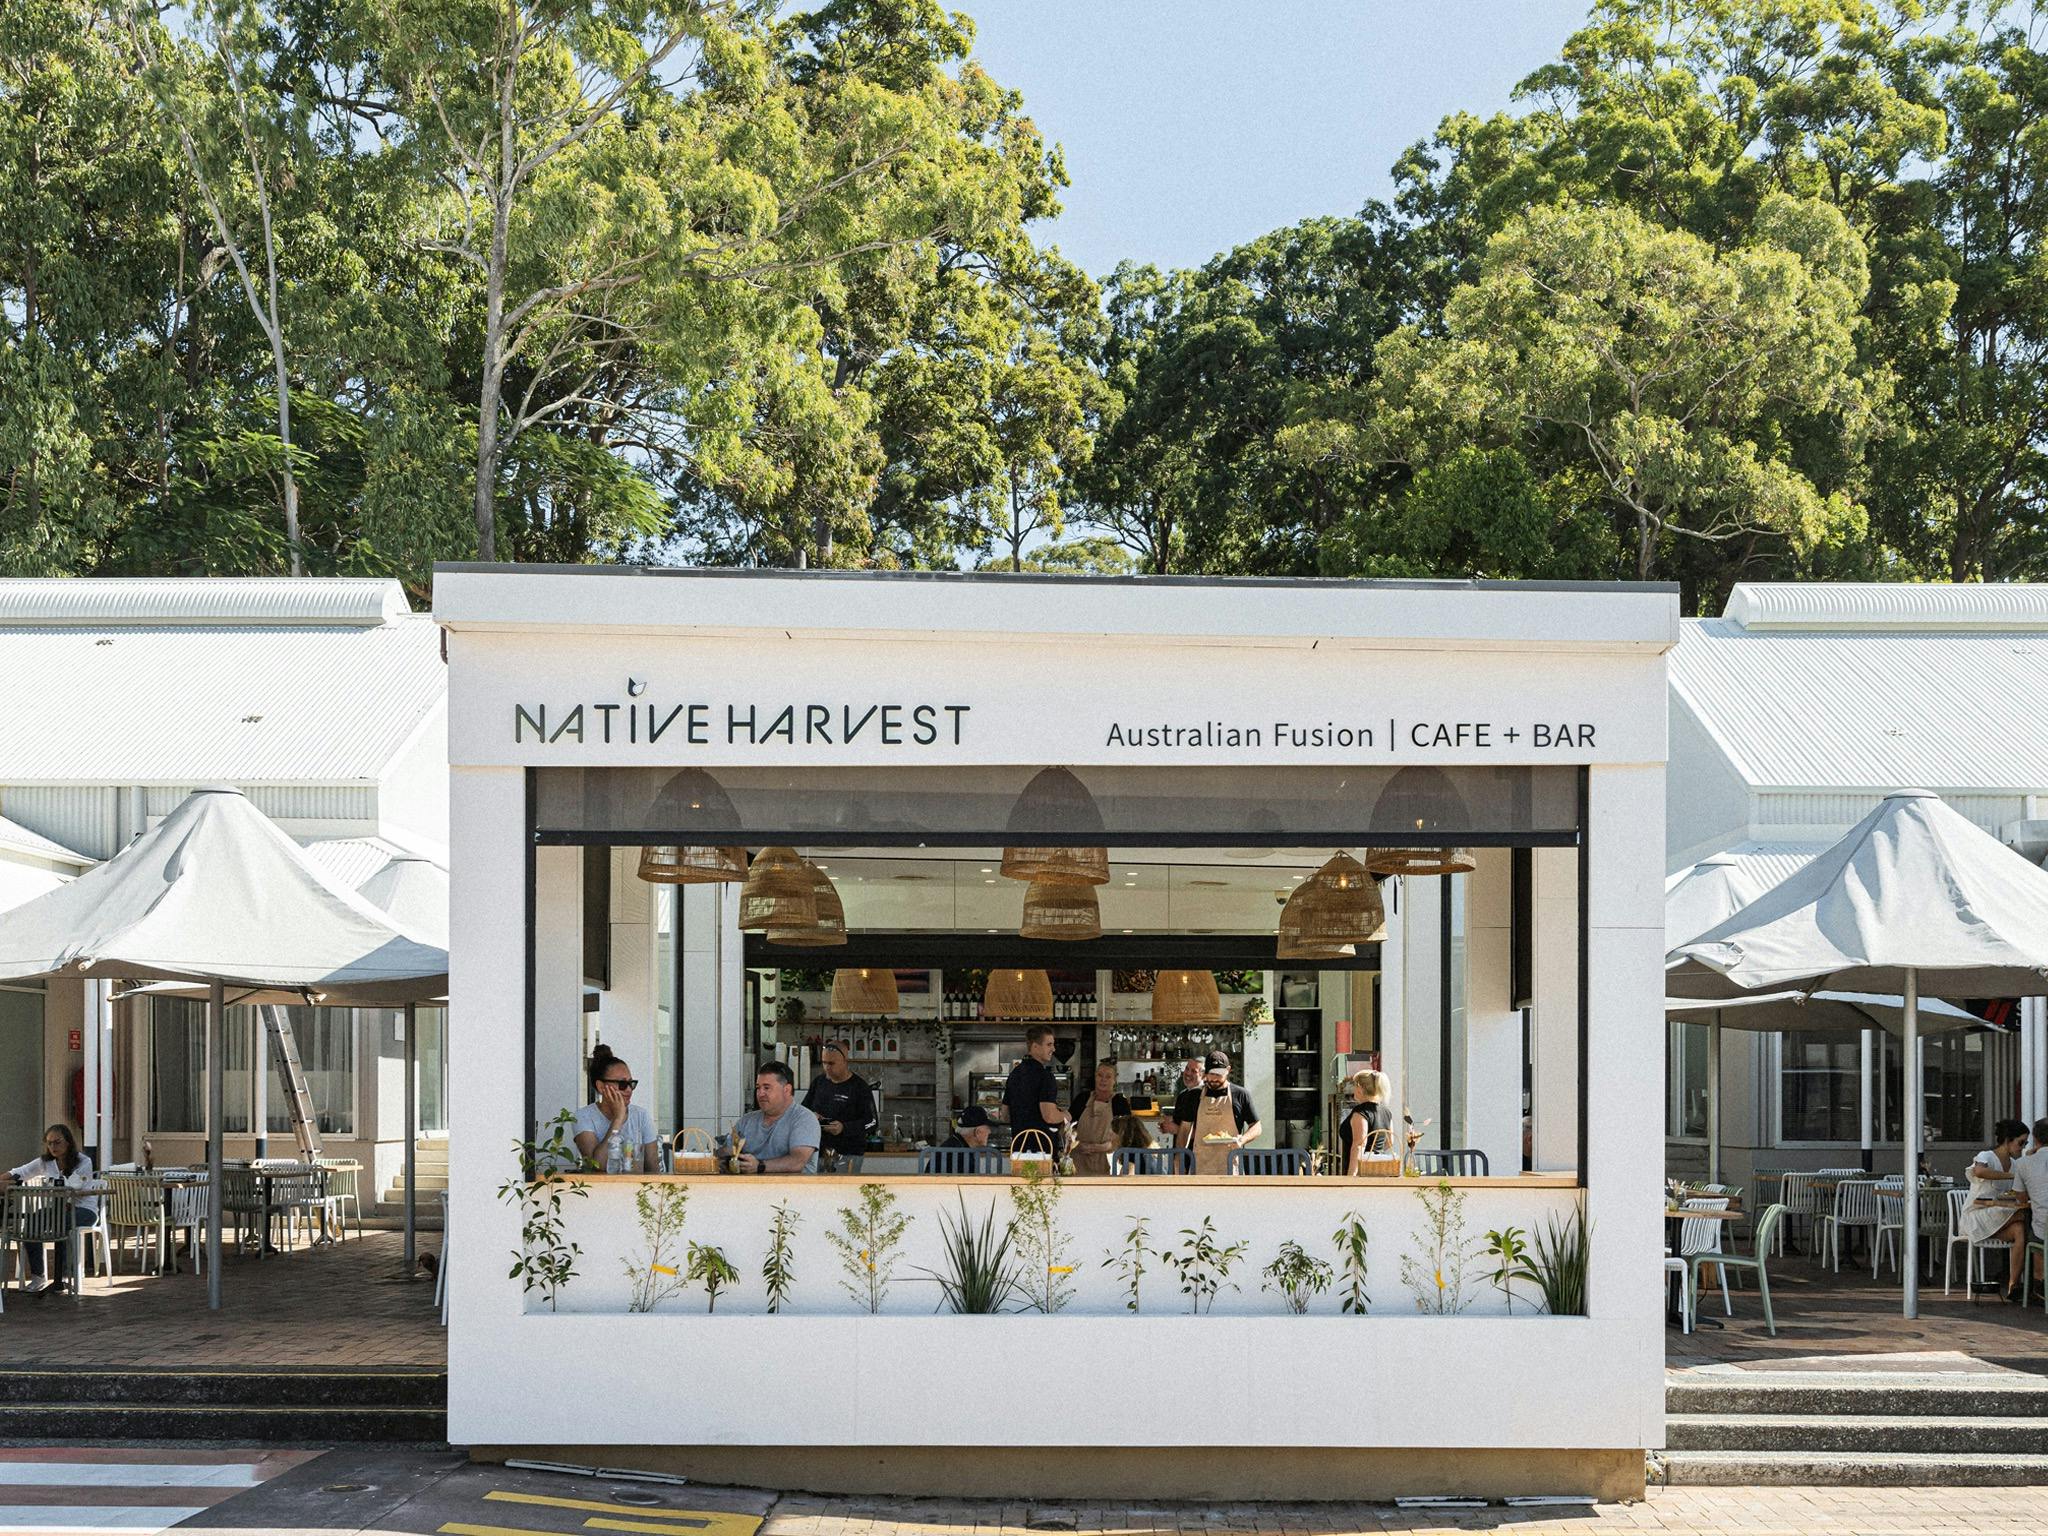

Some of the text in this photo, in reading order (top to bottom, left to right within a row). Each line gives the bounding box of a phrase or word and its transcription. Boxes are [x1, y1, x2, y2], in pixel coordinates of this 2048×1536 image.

[727, 703, 971, 746] HARVEST
[1106, 721, 1261, 748] Australian
[1274, 721, 1373, 748] Fusion
[1411, 722, 1492, 748] CAFE
[1533, 723, 1596, 748] BAR
